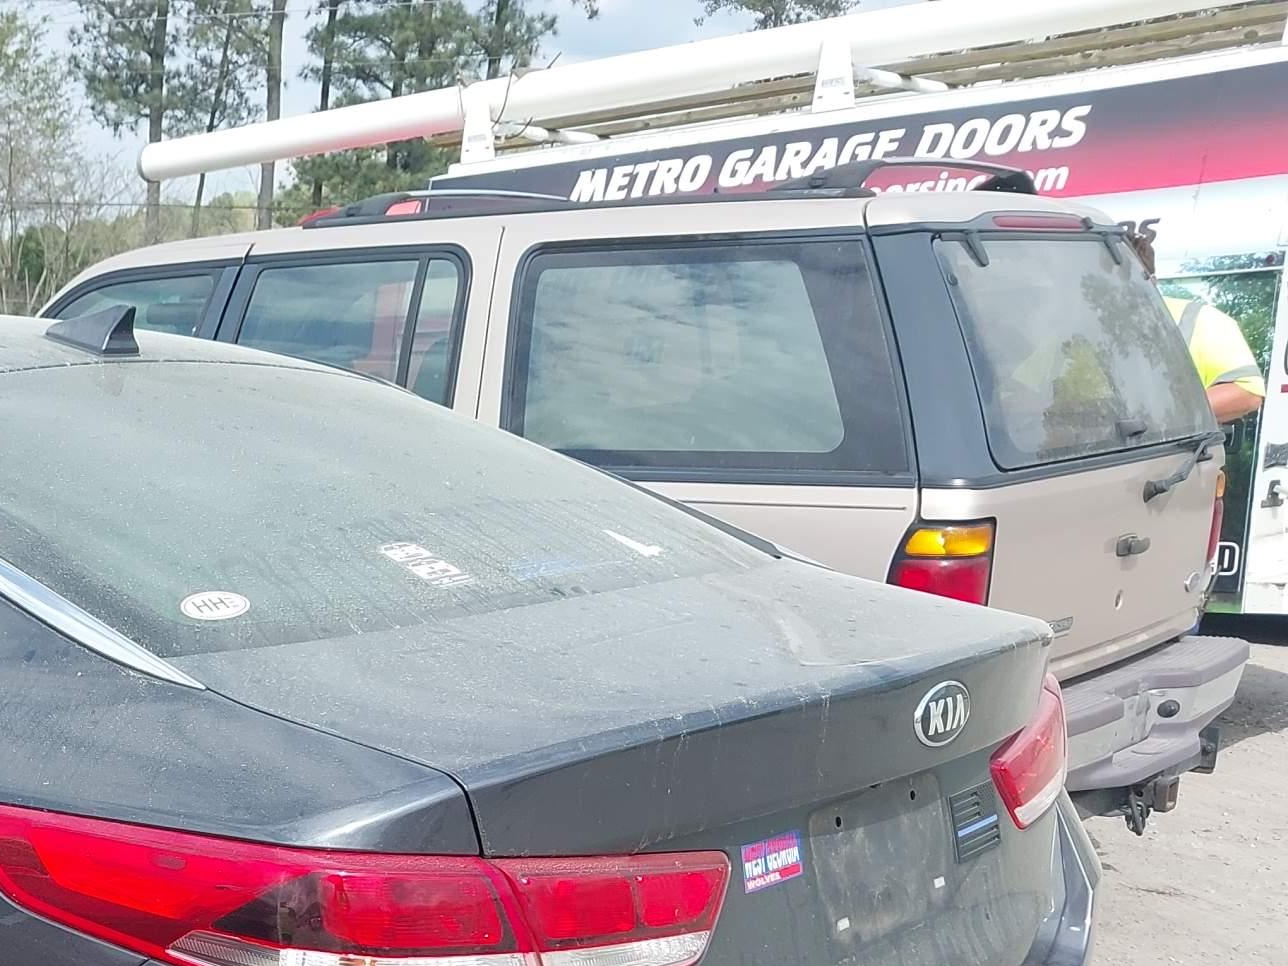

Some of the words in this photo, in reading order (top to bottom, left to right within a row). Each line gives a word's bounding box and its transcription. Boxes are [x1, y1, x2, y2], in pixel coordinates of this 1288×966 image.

[569, 154, 712, 202] METRO
[718, 128, 906, 187] GARAGE
[913, 105, 1092, 159] DOORS
[928, 693, 966, 736] KIA
